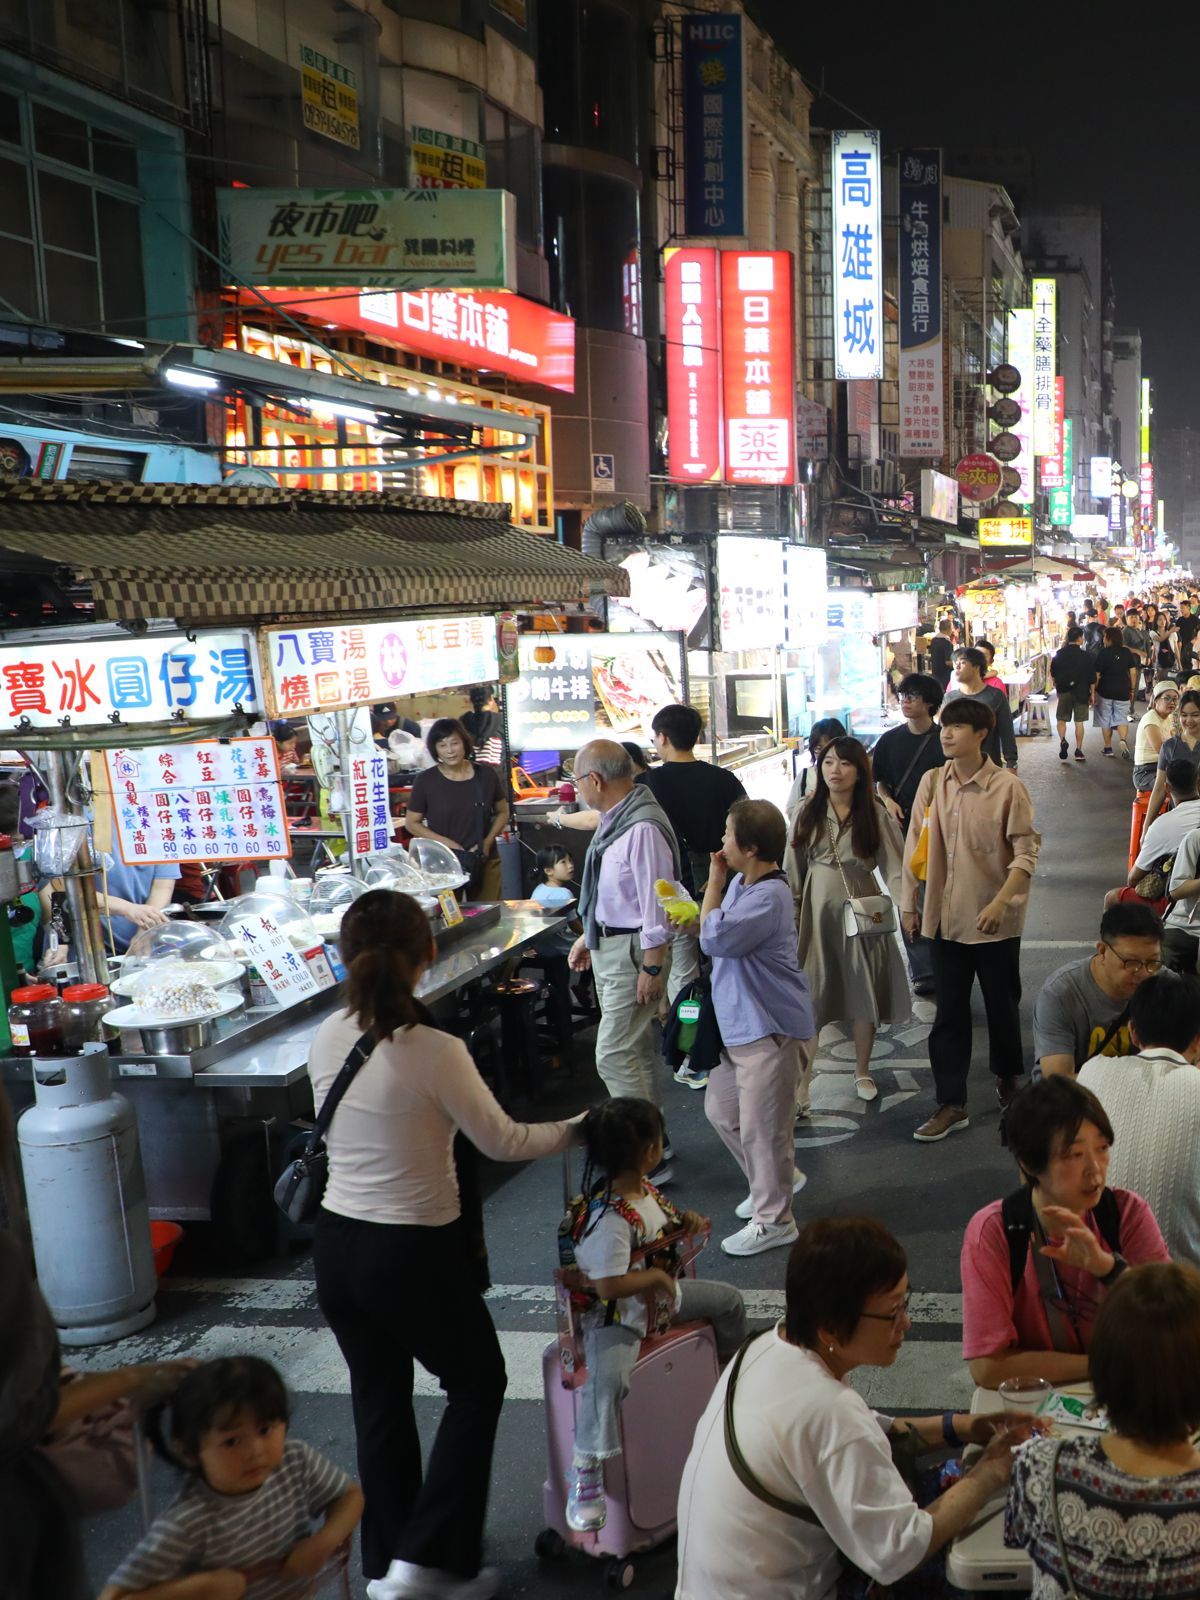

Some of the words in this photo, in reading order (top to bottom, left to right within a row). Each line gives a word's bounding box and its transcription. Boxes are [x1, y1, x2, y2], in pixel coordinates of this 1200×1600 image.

[690, 25, 734, 40] HIIC
[703, 94, 725, 227] 國際新創中心
[268, 203, 379, 238] 夜市吧
[253, 239, 323, 274] yes
[333, 236, 399, 266] bar
[841, 150, 875, 355] 高雄城
[911, 201, 930, 333] 牛角烘焙食品行
[1035, 298, 1053, 411] 十全藥膳排骨
[983, 519, 1029, 539] 雞排
[277, 627, 367, 667] 八寶湯
[415, 619, 485, 652] 紅豆湯
[280, 667, 371, 709] 燒圓湯
[158, 753, 177, 784] 綜合
[196, 751, 215, 782] 紅豆
[231, 748, 248, 779] 花生
[254, 747, 271, 778] 草莓
[122, 808, 137, 829] 地瓜
[155, 792, 177, 841] 圓仔湯
[174, 793, 197, 840] 八寶冰
[196, 791, 218, 839] 圓仔湯
[215, 790, 237, 838] 煉乳冰
[237, 788, 259, 837] 圓仔湯
[258, 787, 280, 836] 烏梅冰
[353, 759, 371, 853] 紅豆湯圓
[371, 757, 388, 850] 花生湯圓
[132, 831, 148, 855] 湯圓
[163, 842, 177, 853] 60
[183, 843, 197, 855] 60
[205, 842, 219, 854] 60
[224, 842, 239, 854] 70
[245, 842, 260, 853] 60
[267, 840, 281, 852] 50
[238, 925, 257, 944] 冰
[271, 936, 286, 948] HOT
[249, 944, 266, 957] ICE
[281, 952, 301, 972] 涼
[291, 971, 309, 986] COLD
